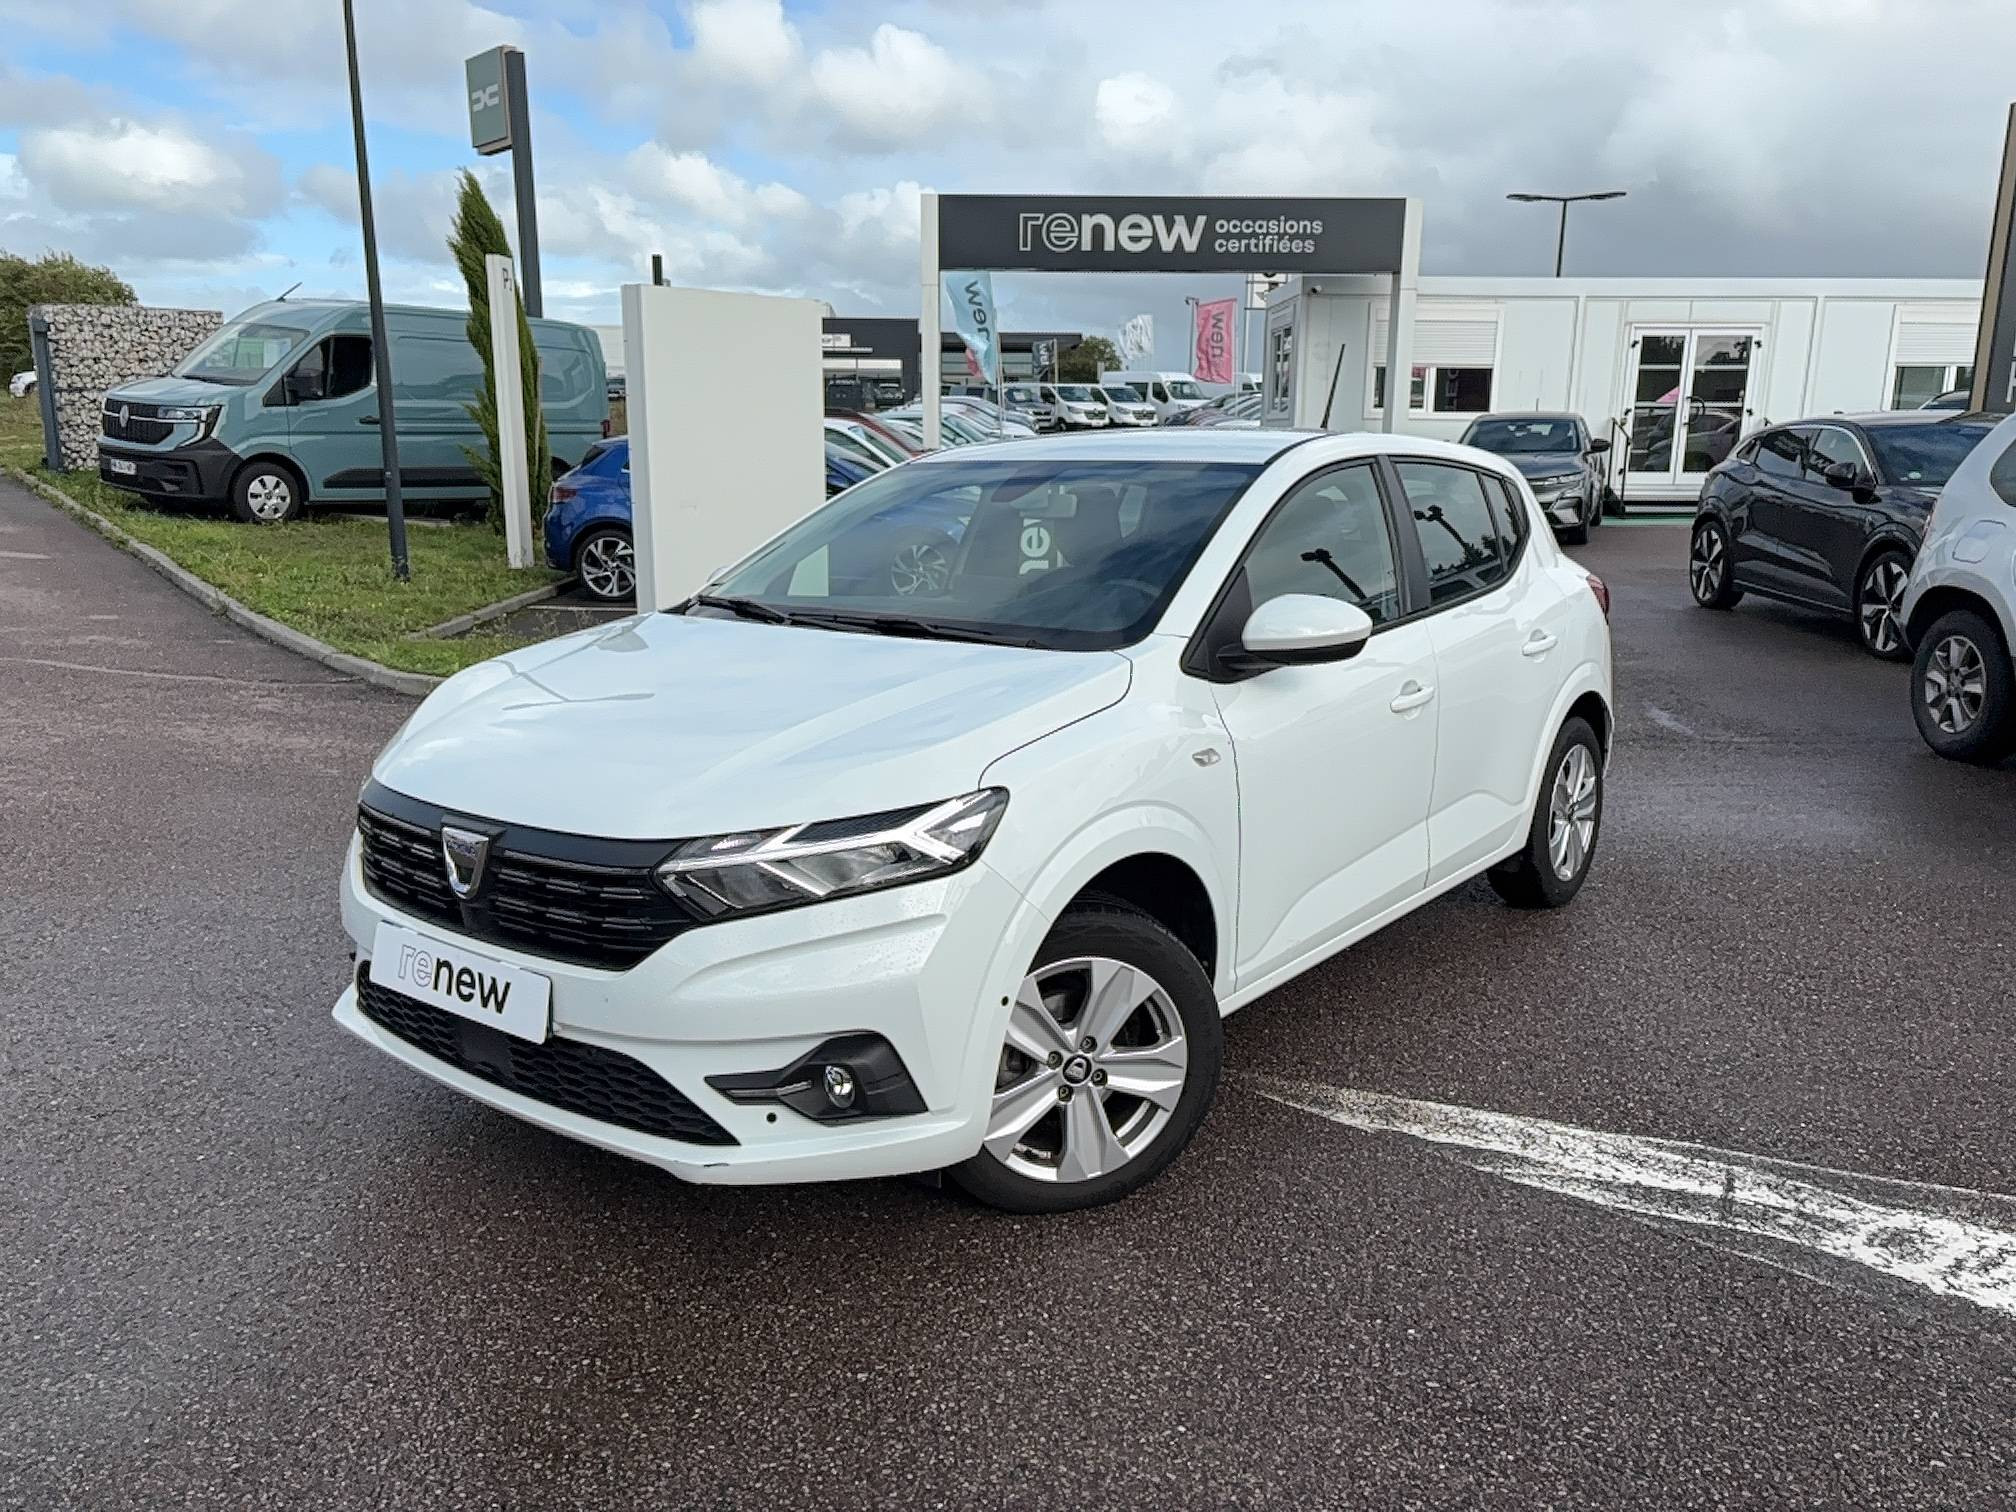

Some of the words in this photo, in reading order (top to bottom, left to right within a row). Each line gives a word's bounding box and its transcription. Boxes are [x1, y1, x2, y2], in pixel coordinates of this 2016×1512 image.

[1018, 212, 1207, 253] renew
[1214, 215, 1323, 234] occasions
[1214, 234, 1316, 253] certifiées
[1019, 518, 1051, 575] ne
[398, 944, 512, 1015] renew
